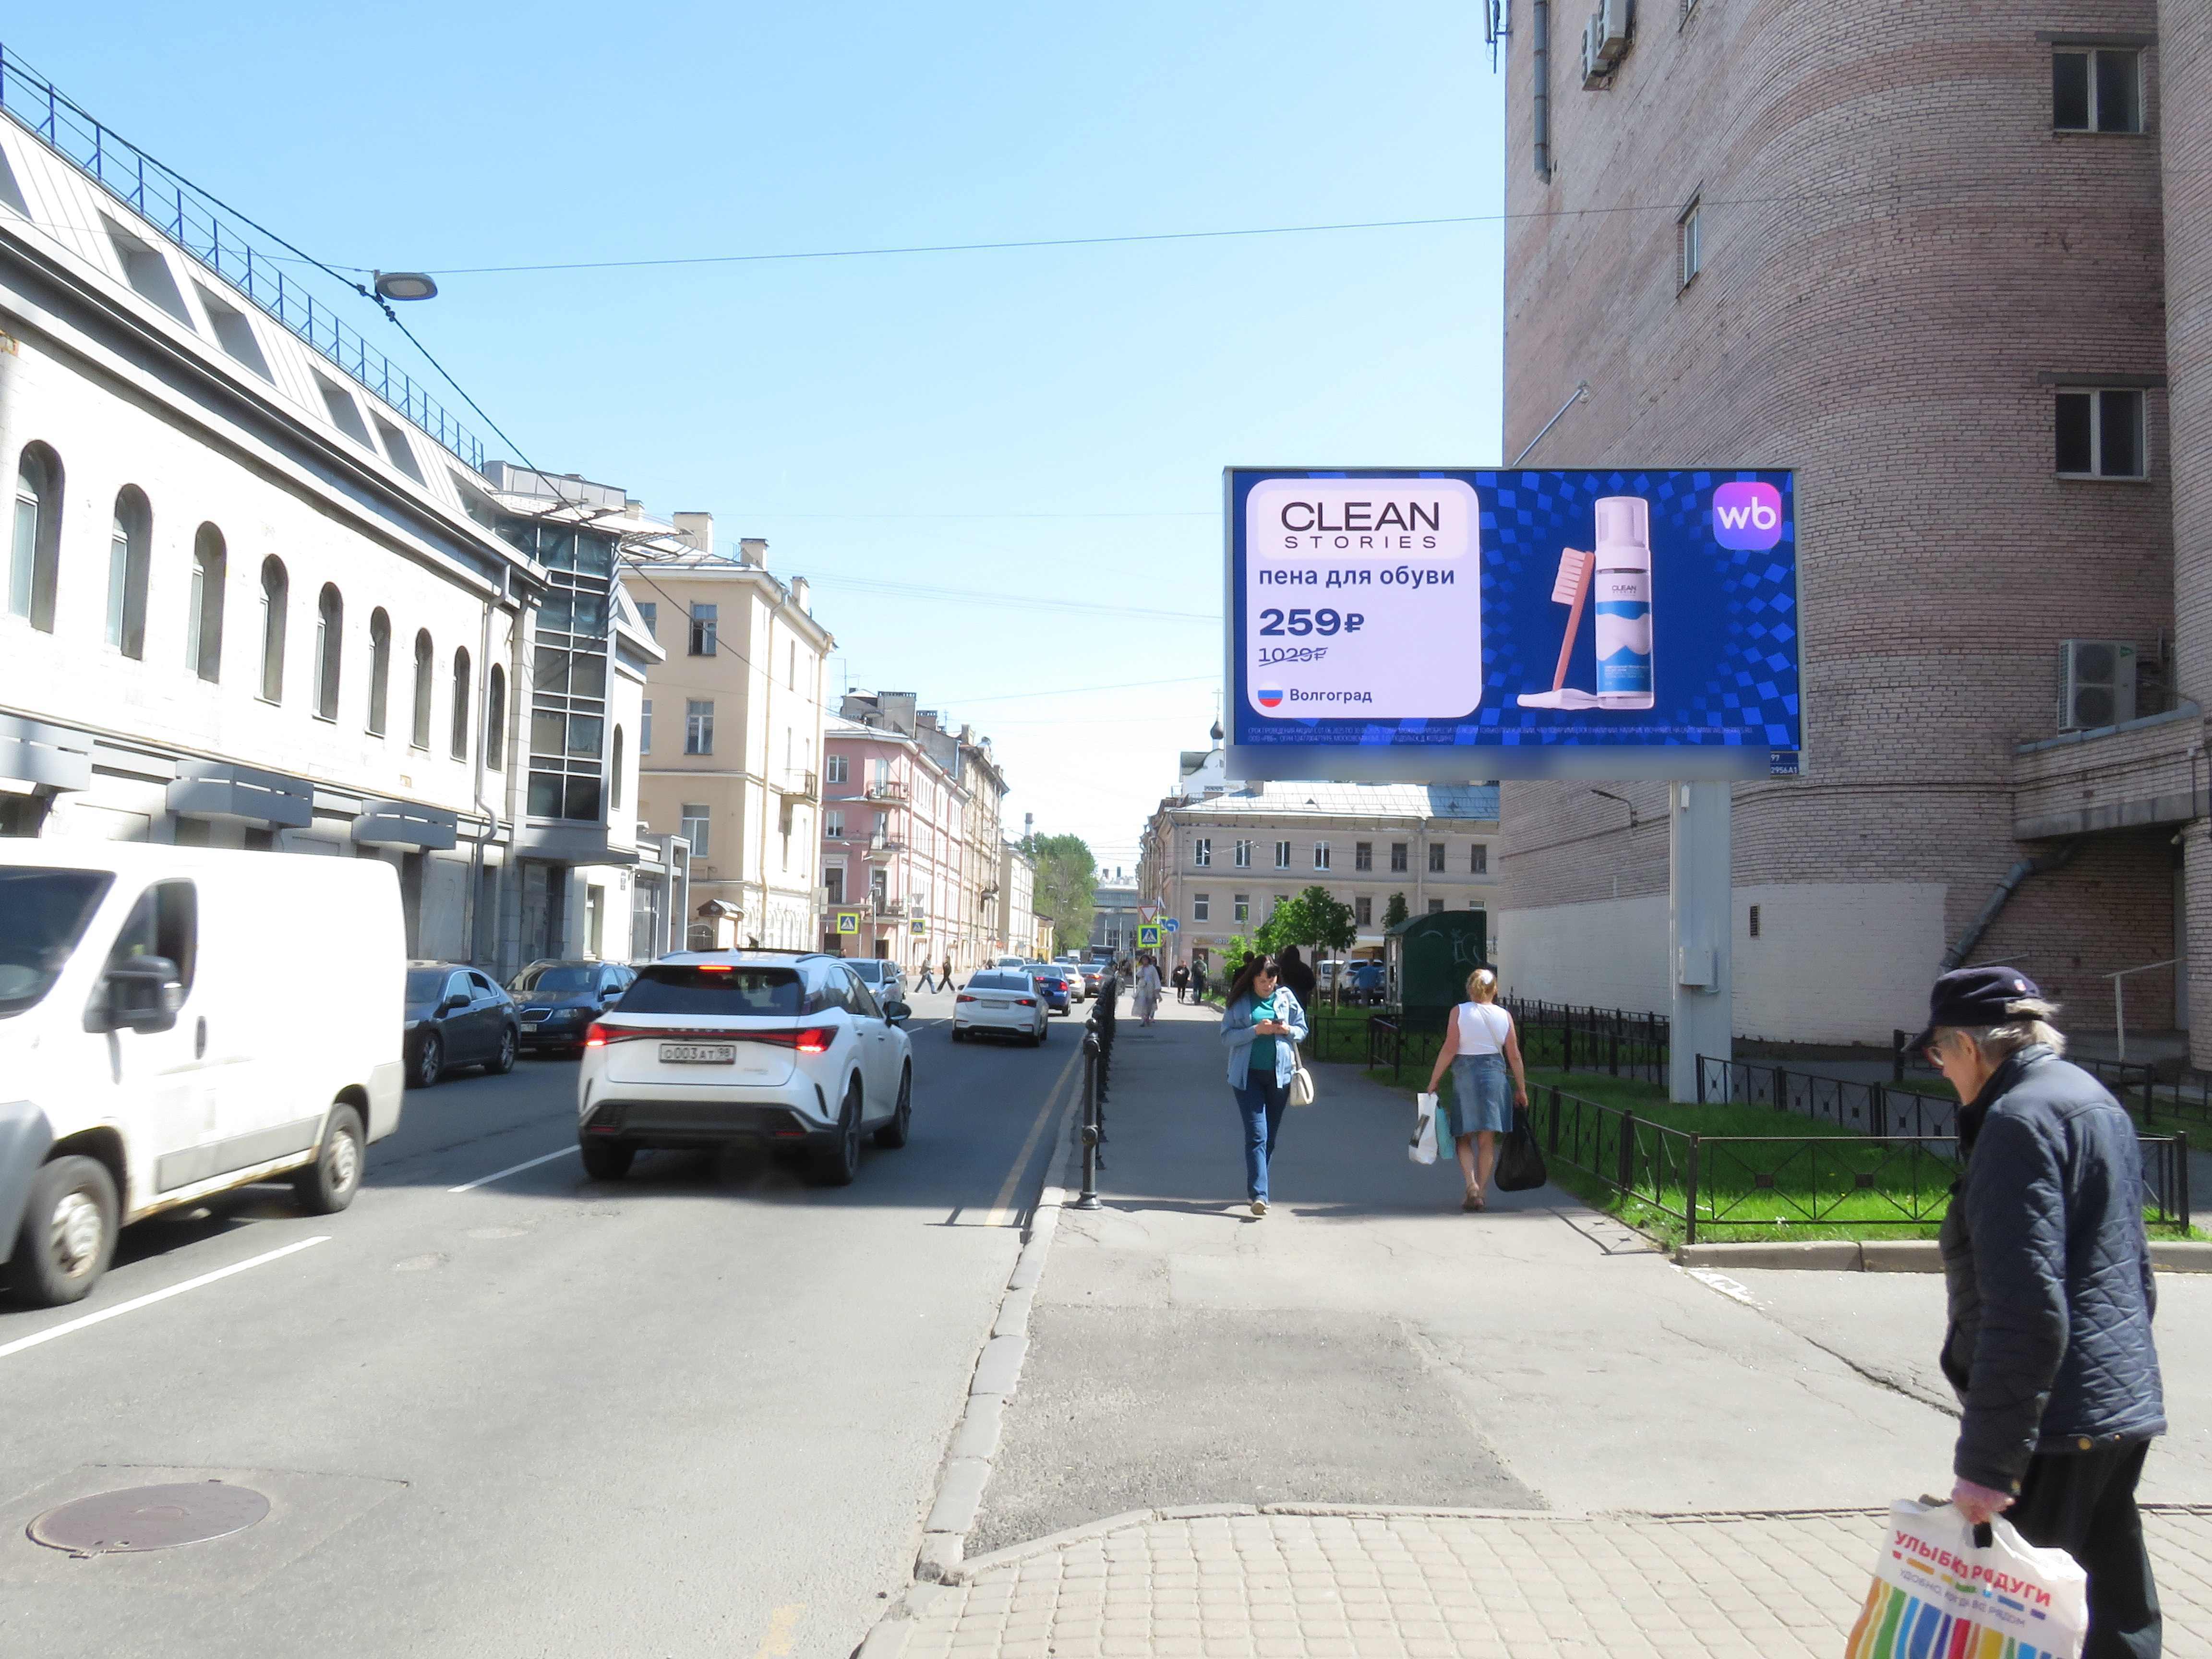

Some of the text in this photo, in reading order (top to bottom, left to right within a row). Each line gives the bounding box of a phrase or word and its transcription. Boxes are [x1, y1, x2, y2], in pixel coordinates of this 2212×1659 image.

[1281, 502, 1440, 531] CLEAN
[1717, 496, 1776, 530] wb
[1285, 536, 1437, 549] STORIES
[1259, 566, 1455, 589] пена для обуви
[1259, 608, 1365, 636] 259₽
[1289, 688, 1372, 703] Волгоград
